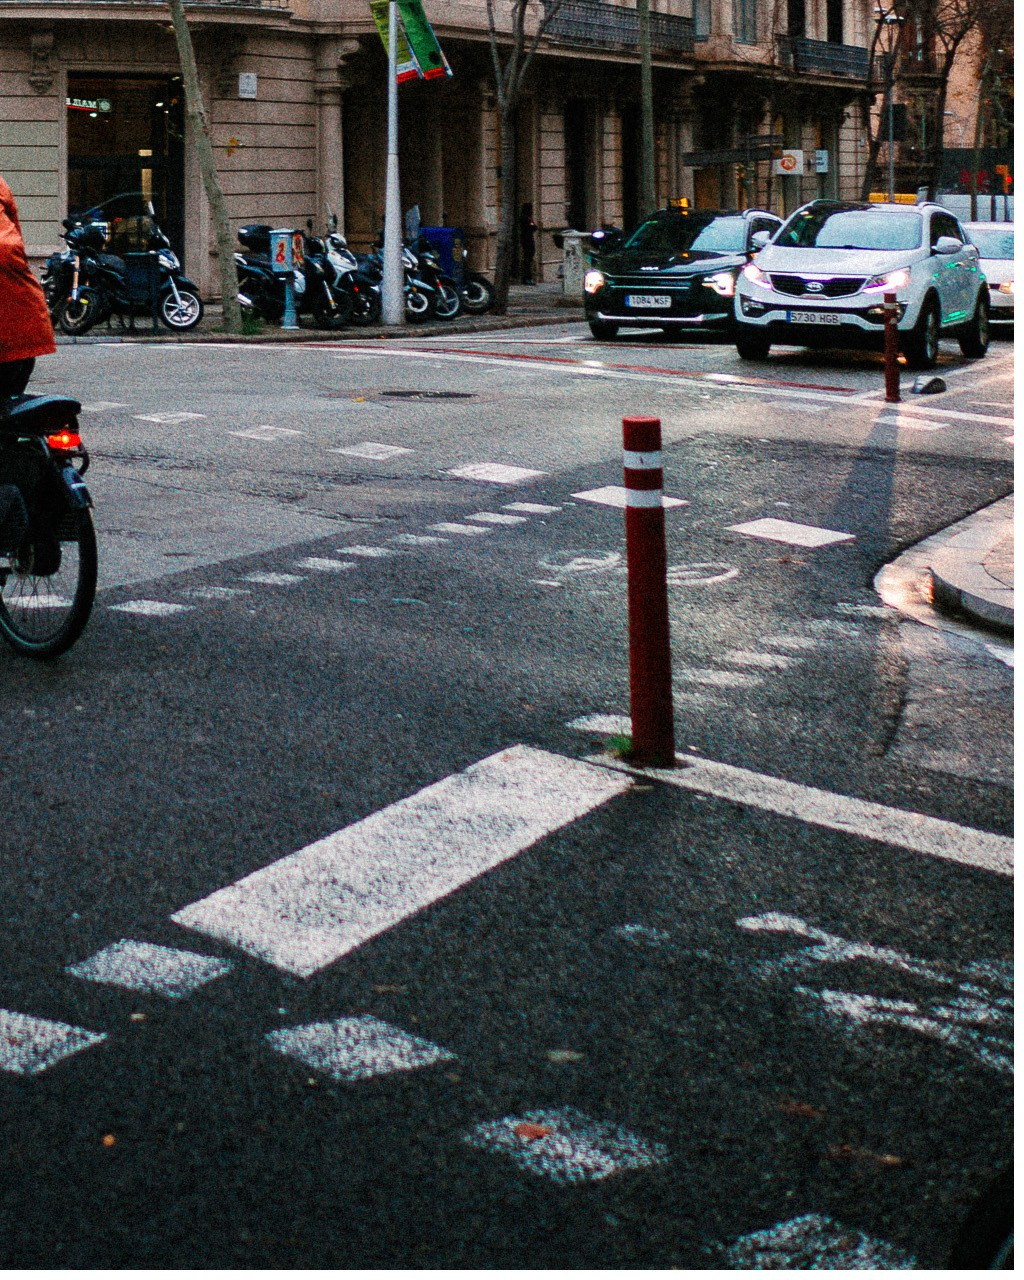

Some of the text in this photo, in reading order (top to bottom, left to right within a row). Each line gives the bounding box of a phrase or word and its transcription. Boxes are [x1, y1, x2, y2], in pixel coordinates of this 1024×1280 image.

[654, 297, 670, 305] MSF
[790, 312, 839, 324] 5730 HGB
